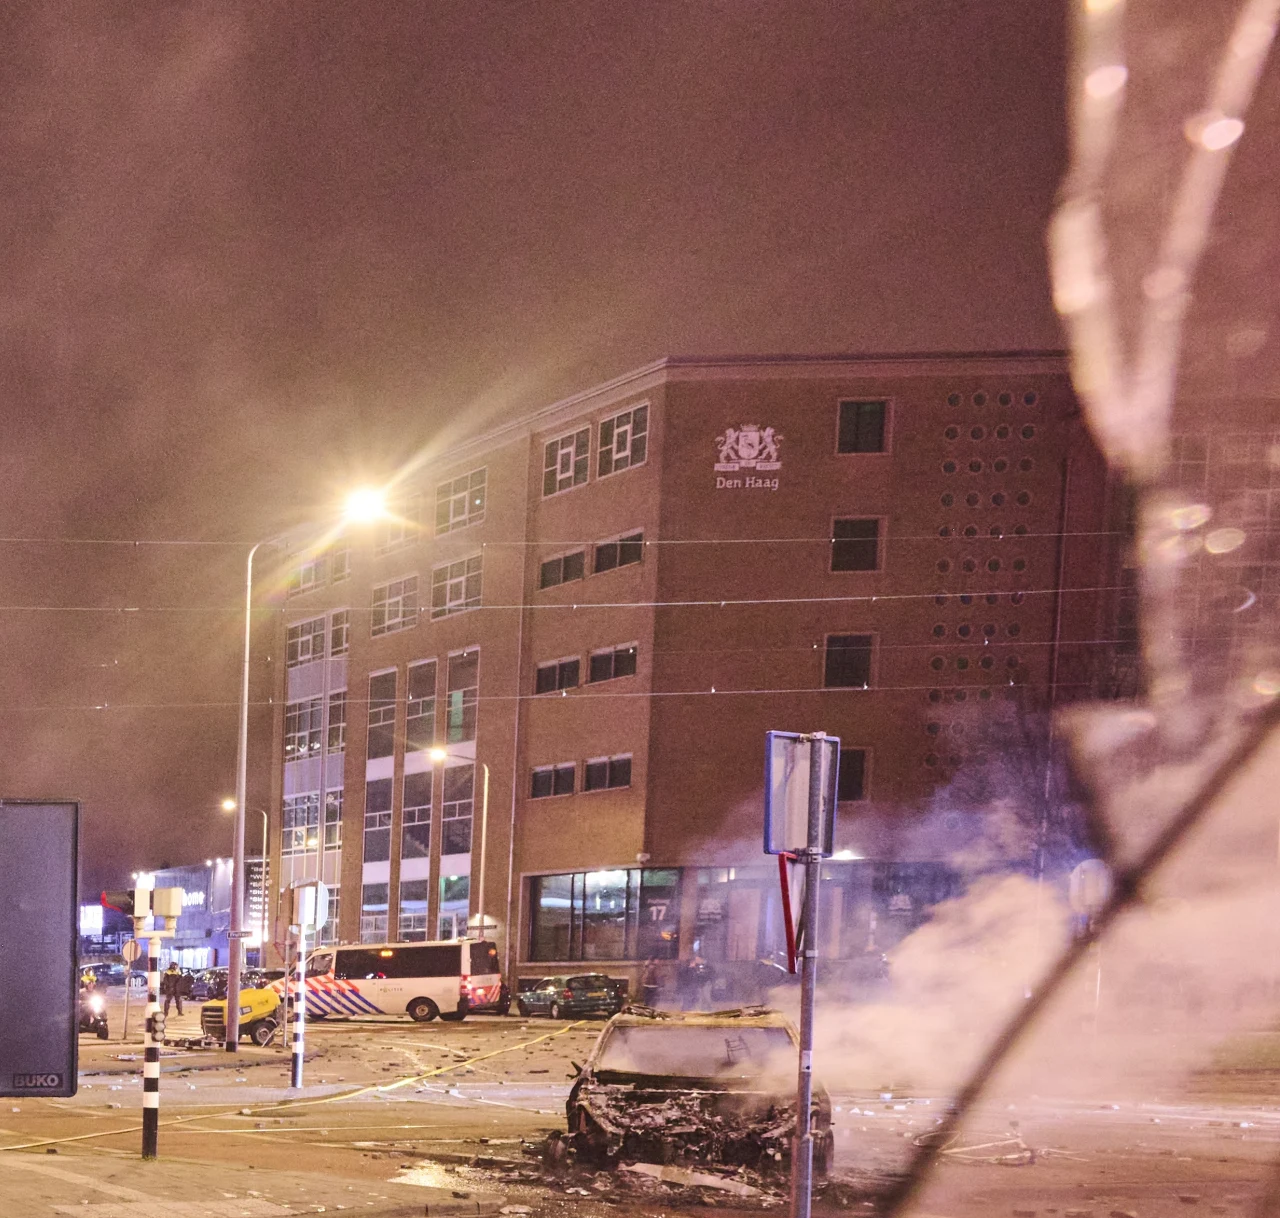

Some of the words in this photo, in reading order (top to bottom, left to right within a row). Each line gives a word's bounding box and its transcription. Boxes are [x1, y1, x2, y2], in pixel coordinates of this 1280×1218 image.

[716, 477, 741, 488] Den
[745, 476, 779, 490] Haag
[649, 906, 667, 921] 17
[14, 1074, 59, 1087] BUKO
